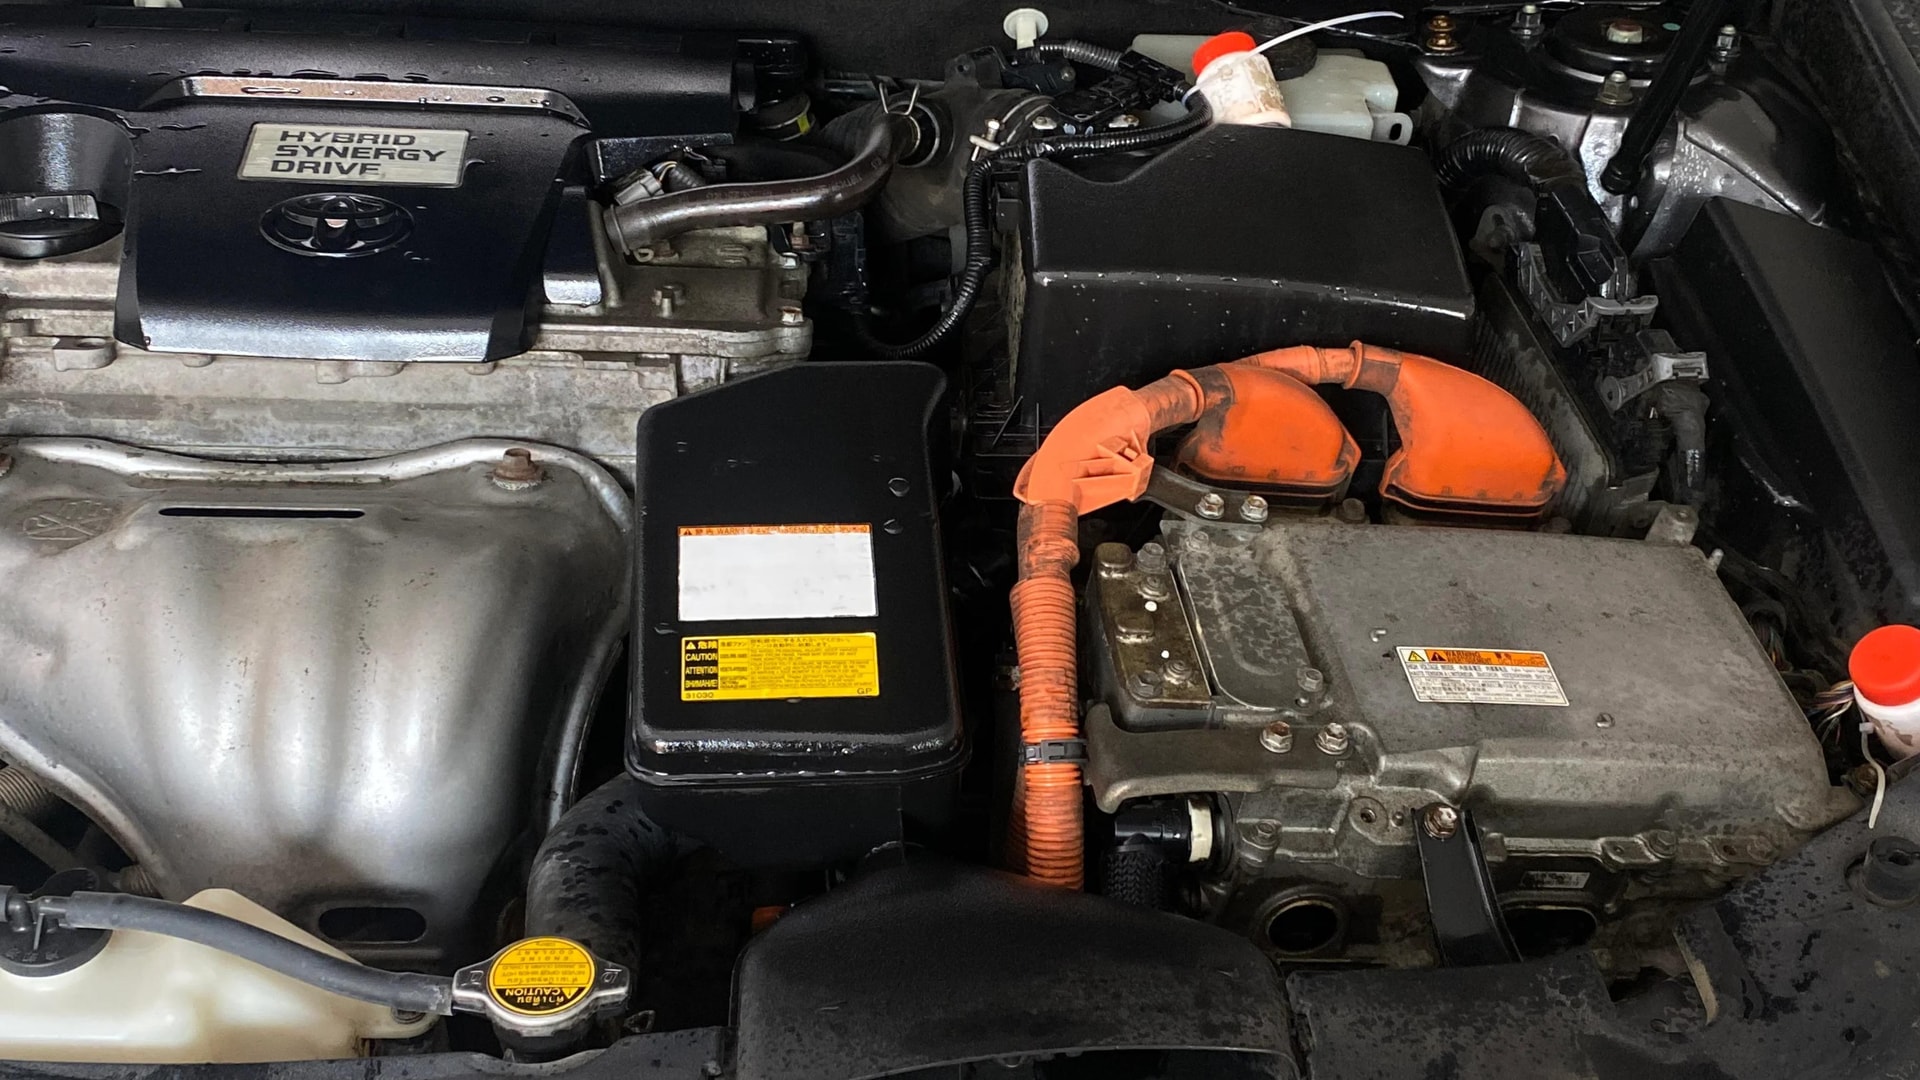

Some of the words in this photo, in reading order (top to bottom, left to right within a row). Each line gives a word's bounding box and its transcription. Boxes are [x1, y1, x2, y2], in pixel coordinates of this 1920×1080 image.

[280, 131, 416, 146] HYBRID
[275, 145, 446, 162] SYNERGY
[271, 160, 382, 176] DRIVE
[685, 653, 718, 661] CAUTION
[685, 666, 718, 675] ATTENTION
[856, 687, 873, 695] GP
[505, 987, 561, 996] CAUTION
